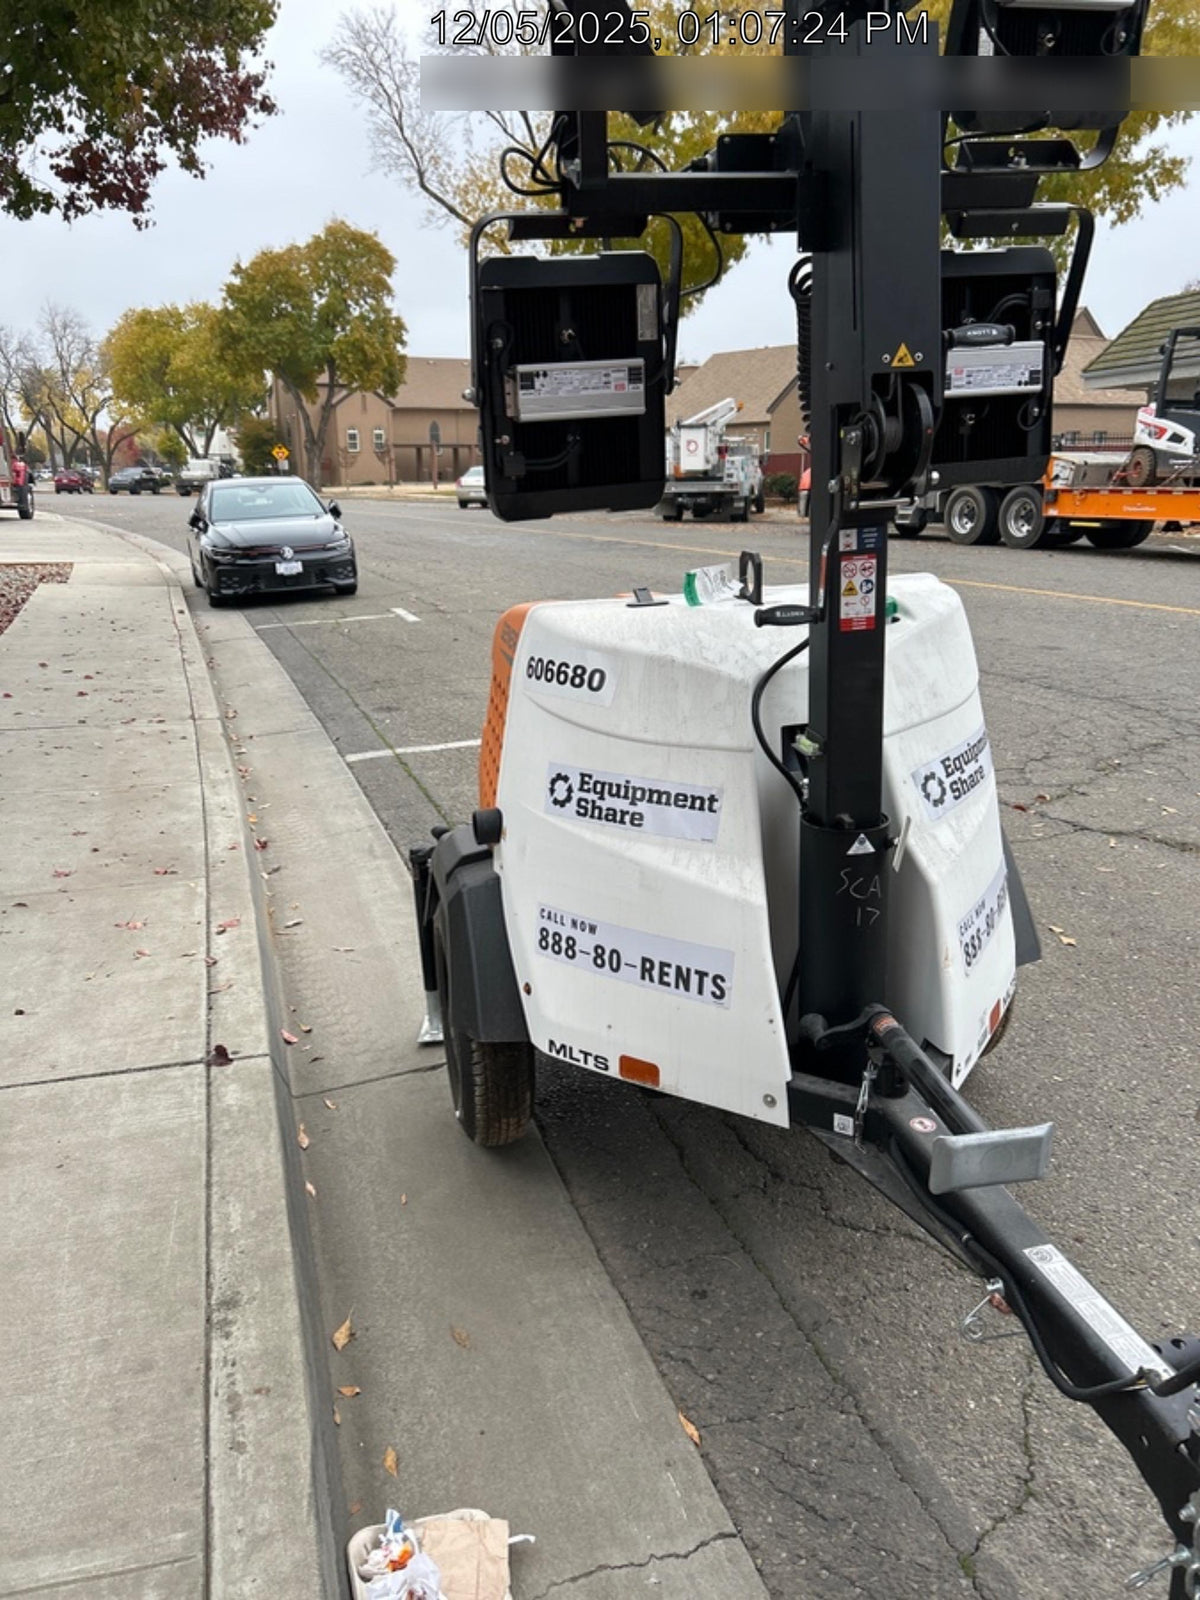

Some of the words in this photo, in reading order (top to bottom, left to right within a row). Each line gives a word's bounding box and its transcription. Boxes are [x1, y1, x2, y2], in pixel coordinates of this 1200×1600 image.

[526, 656, 607, 692] 606680
[577, 772, 719, 813] Equipment
[949, 765, 985, 801] Share
[576, 797, 644, 828] Share
[540, 907, 566, 927] CALL
[570, 918, 598, 936] NOW
[538, 926, 727, 1000] 888-80-RENTS
[548, 1039, 610, 1072] MLTS
